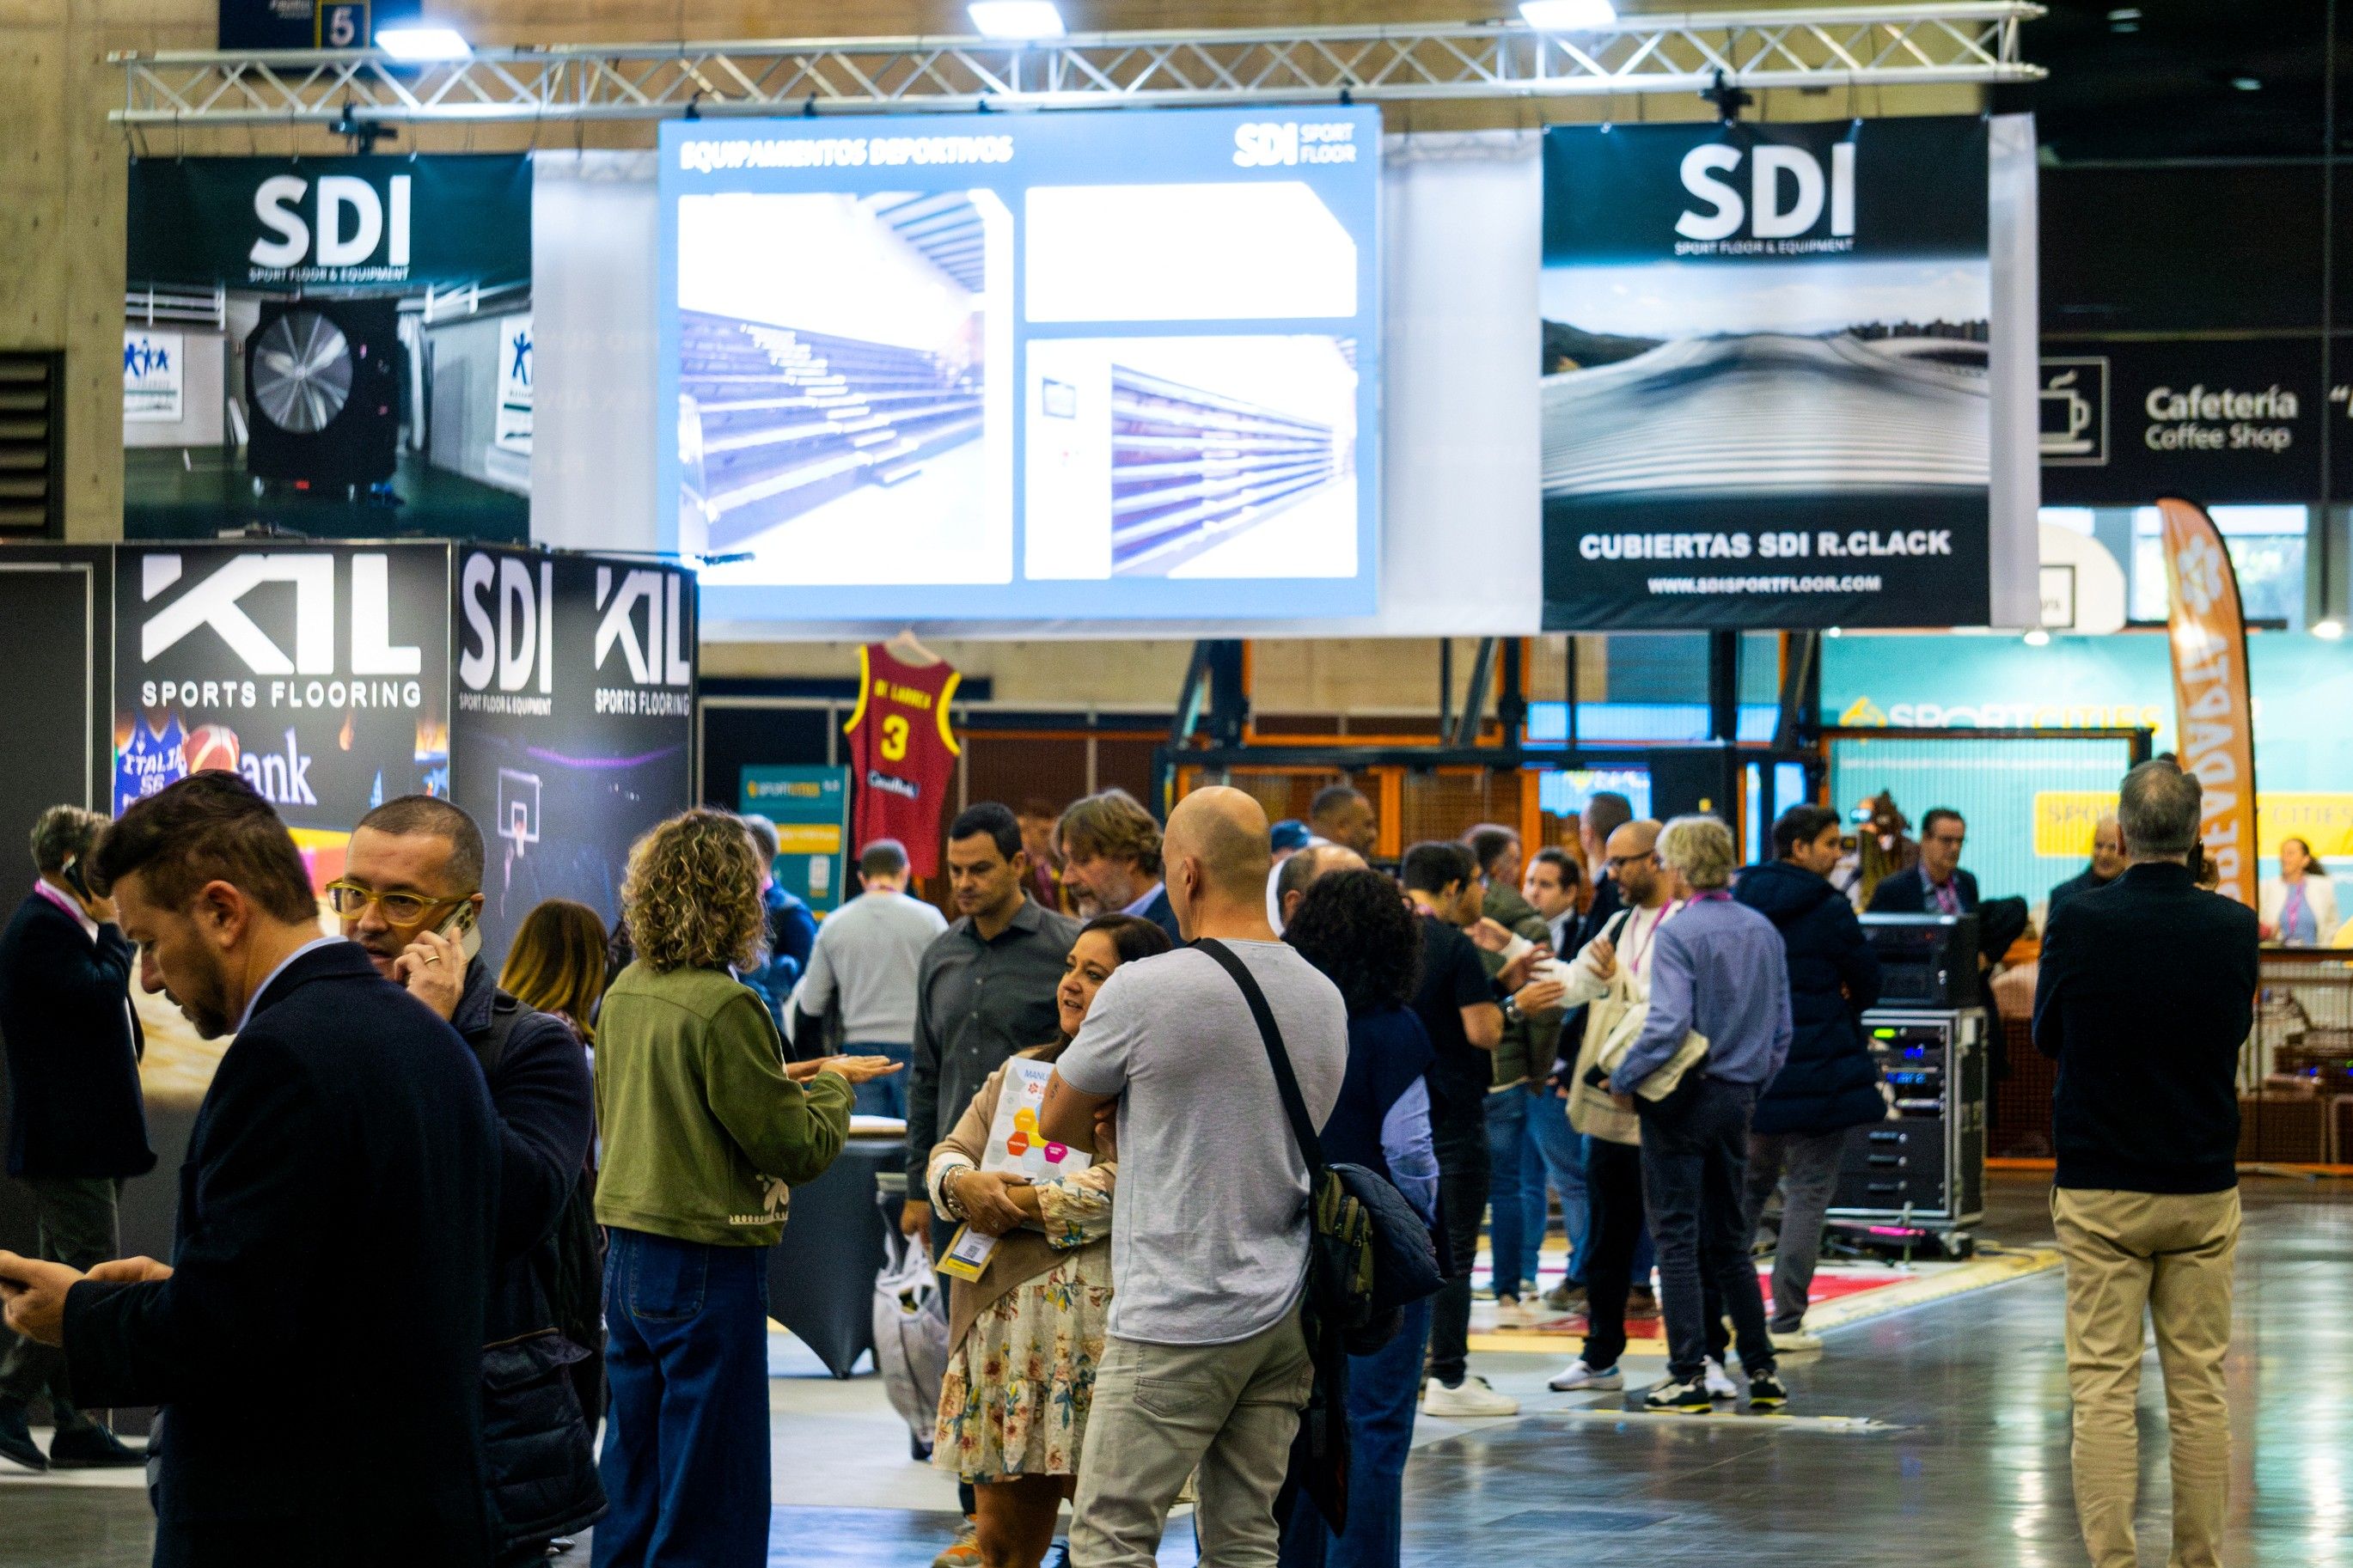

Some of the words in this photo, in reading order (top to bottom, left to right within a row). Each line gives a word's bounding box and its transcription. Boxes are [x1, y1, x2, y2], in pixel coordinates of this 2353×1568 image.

[330, 6, 354, 46] 5
[1232, 123, 1298, 168] SDI
[1300, 123, 1355, 143] SPORT
[869, 136, 1013, 165] DEPORTIVOS
[1300, 143, 1356, 163] FLOOR
[1675, 143, 1855, 241] SDI
[249, 174, 411, 268] SDI
[1675, 241, 1718, 255] SPORT
[1719, 241, 1763, 254] FLOOR
[1778, 238, 1854, 254] EQUIPMENT
[249, 268, 287, 283] SPORT
[289, 267, 327, 282] FLOOR
[339, 266, 409, 283] EQUIPMENT
[2145, 384, 2299, 421] Cafetería
[2145, 424, 2227, 450] Coffee
[2229, 423, 2291, 454] Shop
[1579, 533, 1751, 559] CUBIERTAS
[1758, 533, 1810, 557] SDI
[1818, 530, 1952, 556] R.CLACK
[1647, 576, 1882, 595] WWW.SDISPORTFLOOR.COM
[459, 552, 553, 694] SDI
[142, 680, 257, 708] SPORTS
[271, 680, 421, 708] FLOORING
[459, 692, 481, 711] SPORT
[483, 694, 504, 713] FLOOR
[511, 697, 552, 717] EQUIPMENT
[595, 688, 637, 716] SPORTS
[639, 691, 690, 717] FLOORING
[880, 714, 910, 762] 3
[241, 727, 318, 805] ank
